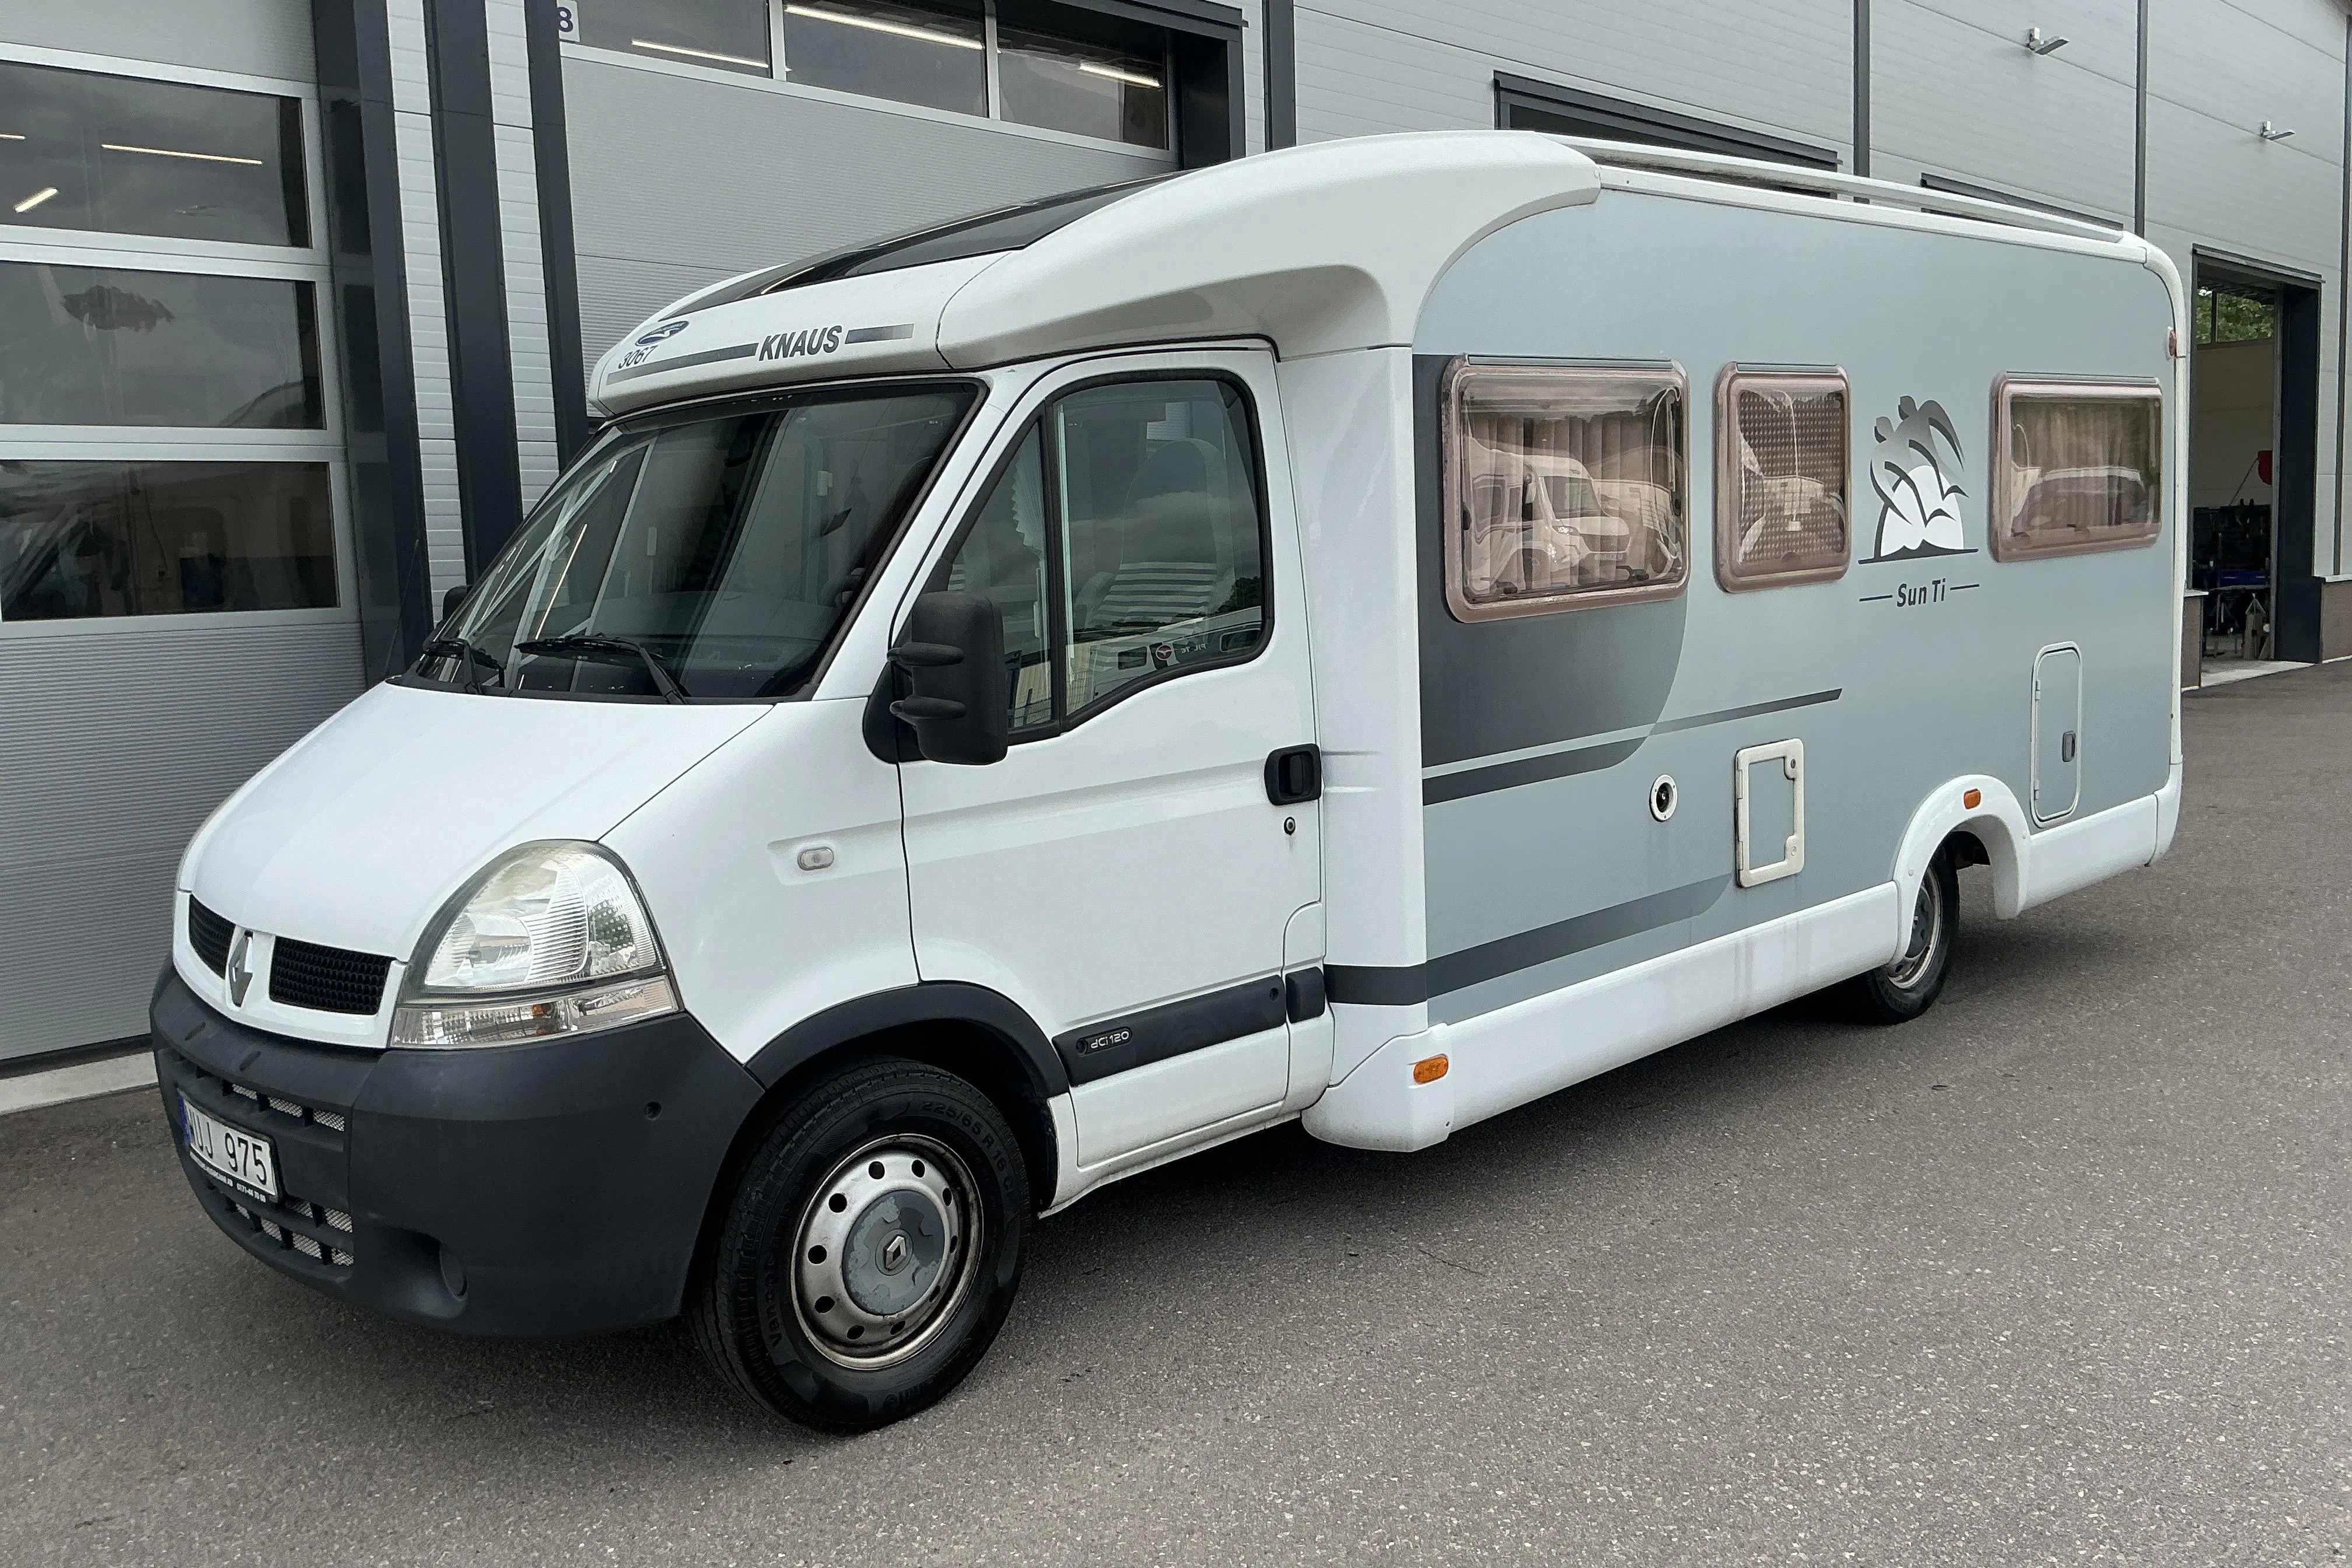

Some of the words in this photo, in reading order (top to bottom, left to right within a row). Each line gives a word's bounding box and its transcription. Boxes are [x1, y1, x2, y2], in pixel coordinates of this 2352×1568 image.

[556, 6, 573, 33] 8
[618, 345, 659, 369] 3067
[758, 325, 842, 362] KNAUS
[1896, 583, 1927, 607] Sun
[1931, 578, 1946, 603] Ti
[225, 1132, 267, 1185] 975
